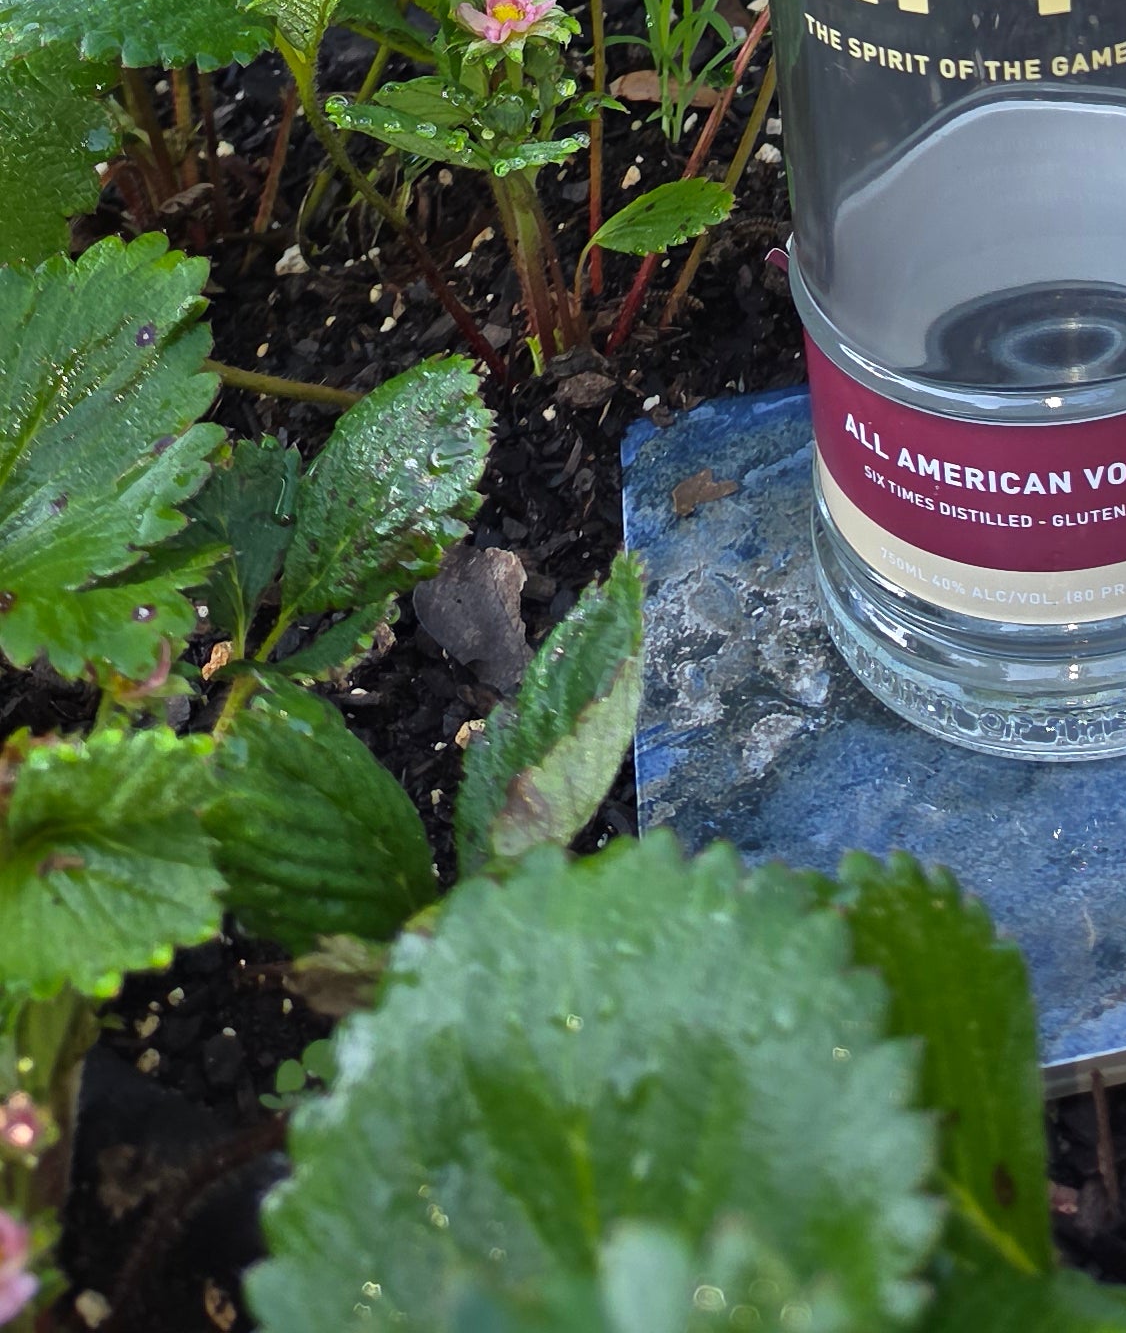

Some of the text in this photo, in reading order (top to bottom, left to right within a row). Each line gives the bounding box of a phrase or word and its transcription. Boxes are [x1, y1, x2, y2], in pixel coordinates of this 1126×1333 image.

[804, 12, 843, 51] THE
[848, 37, 930, 76] SPIRIT
[939, 58, 975, 81] OF
[984, 58, 1042, 82] THE
[845, 412, 890, 460] ALL
[897, 447, 1073, 495] AMERICAN
[864, 464, 886, 489] SIX
[887, 479, 935, 511] TIMES
[939, 501, 1033, 528] DISTILLED
[1052, 504, 1126, 527] GLUTEN
[880, 546, 929, 583] 750ML
[931, 574, 966, 596] 40%
[971, 586, 1060, 605] ALC/VOL.
[1065, 589, 1095, 605] (80
